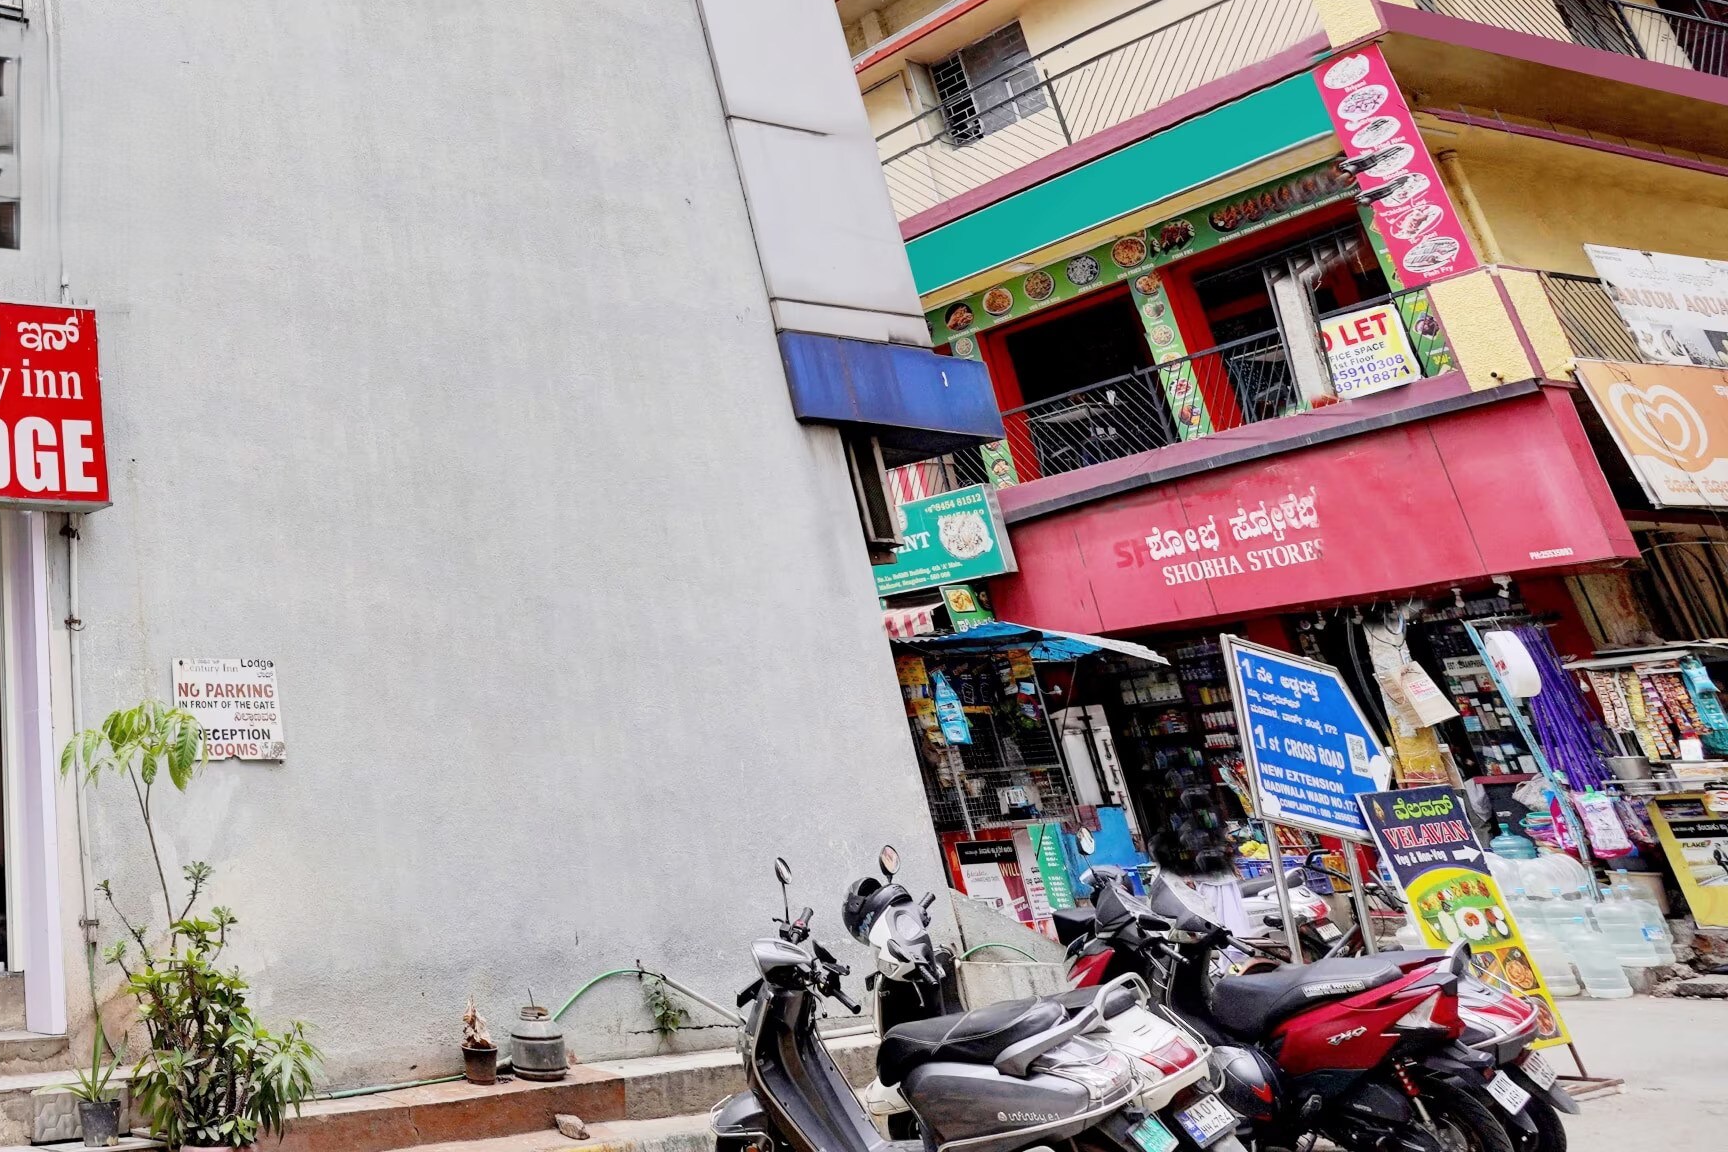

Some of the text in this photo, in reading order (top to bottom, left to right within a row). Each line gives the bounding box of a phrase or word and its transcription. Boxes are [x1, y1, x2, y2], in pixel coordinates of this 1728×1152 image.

[1339, 313, 1387, 346] LET
[1352, 355, 1375, 366] Floor
[1354, 341, 1385, 356] SPACE
[22, 359, 84, 400] inn
[1162, 538, 1324, 586] SHOBHA STORES
[179, 701, 275, 709] IN FRONT OF THE GATE
[206, 683, 274, 698] PARKING
[1284, 737, 1317, 763] CROSS
[1318, 745, 1345, 770] ROAD
[1260, 762, 1344, 794] NEW EXTENSION
[1263, 779, 1306, 800] MADIWALA
[1307, 790, 1330, 805] WARD
[1382, 820, 1469, 849] VELAVAN
